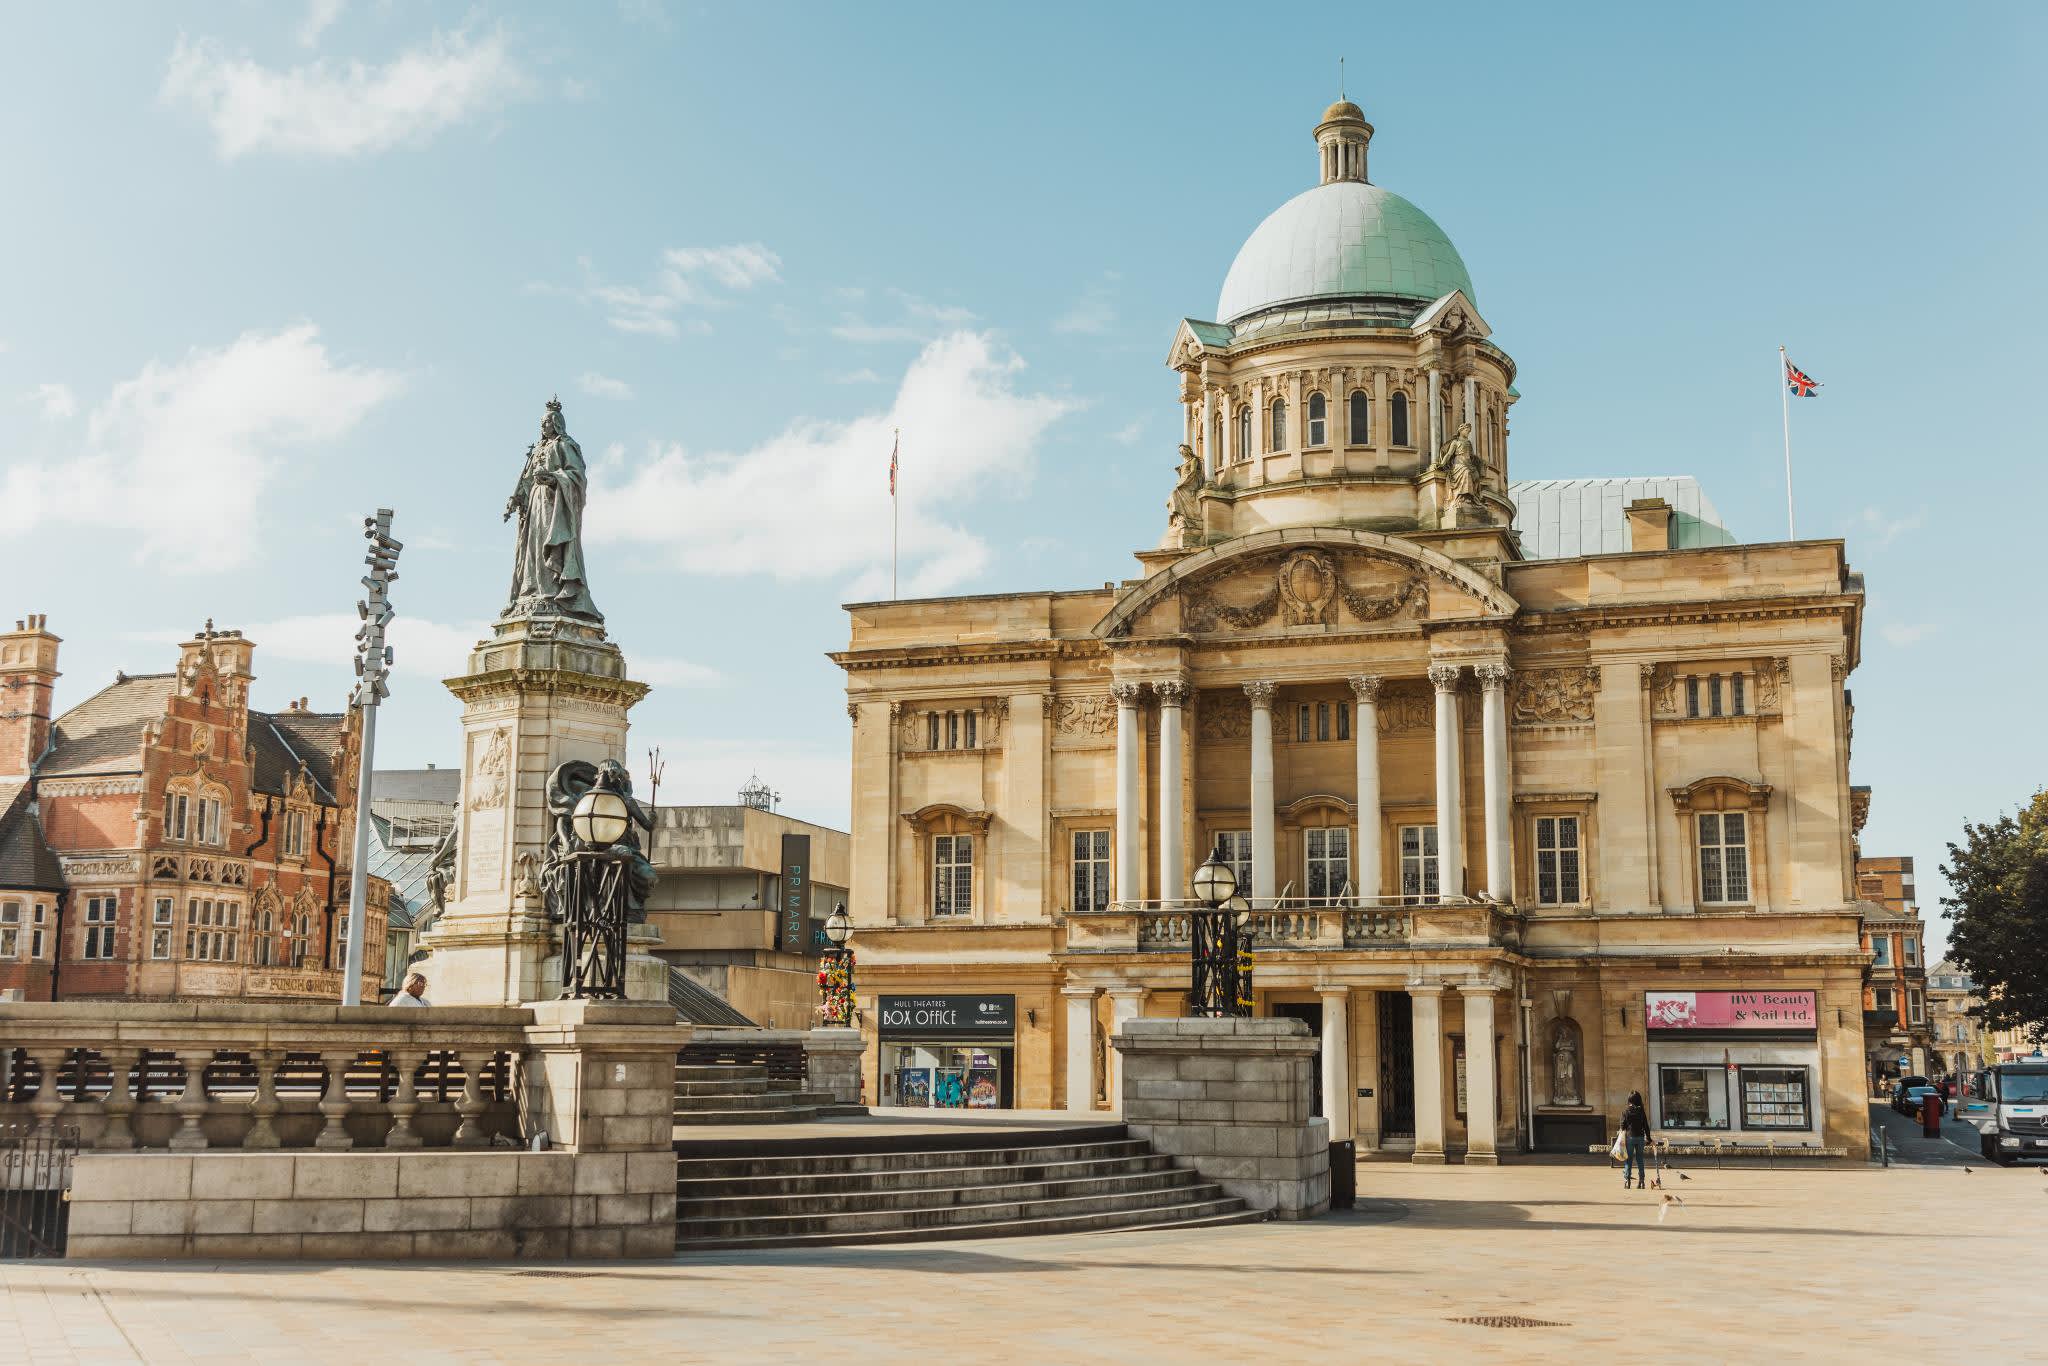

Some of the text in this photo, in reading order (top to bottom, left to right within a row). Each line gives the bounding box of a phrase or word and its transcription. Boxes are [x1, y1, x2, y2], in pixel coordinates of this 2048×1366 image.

[788, 865, 801, 944] PRIMARK
[270, 978, 305, 991] PUNCH
[1763, 994, 1809, 1006] Beauty
[883, 1010, 957, 1025] BOX OFFICE
[1735, 1010, 1811, 1020] & Nail Ltd.
[5, 1153, 78, 1168] GENTLEME
